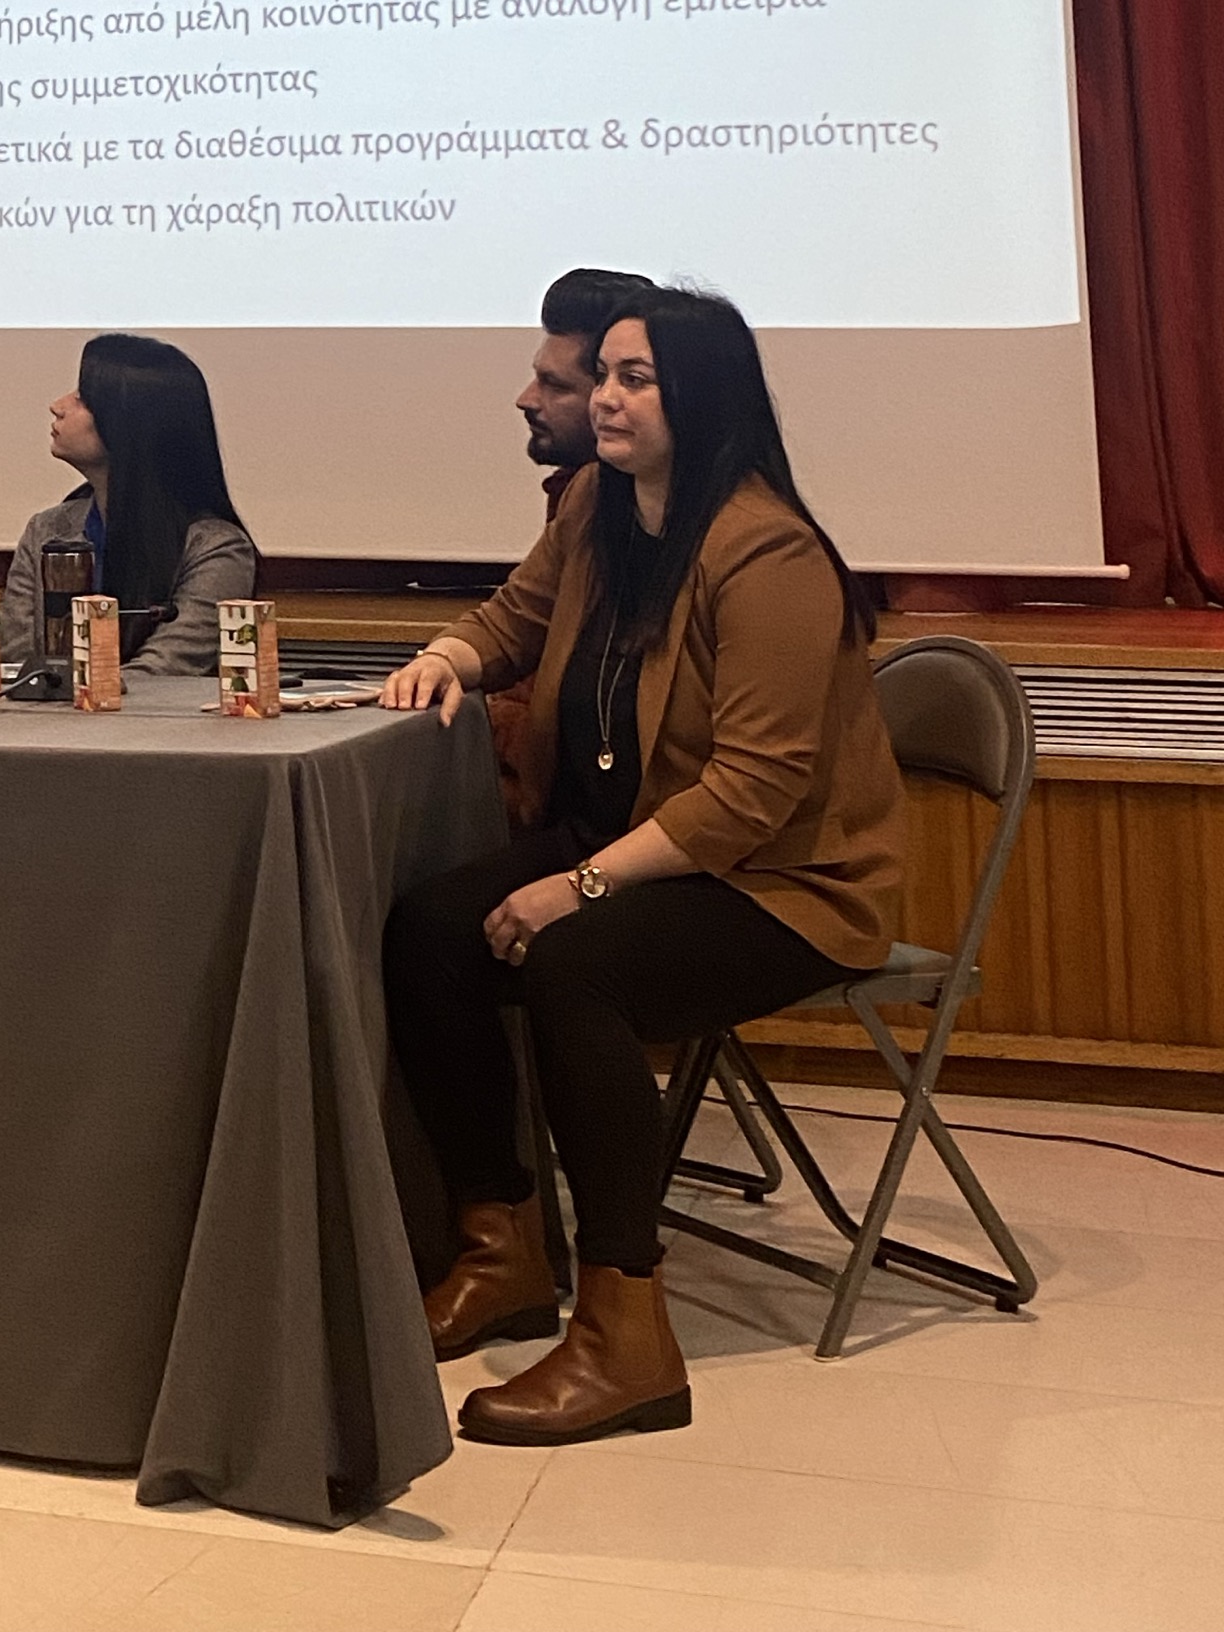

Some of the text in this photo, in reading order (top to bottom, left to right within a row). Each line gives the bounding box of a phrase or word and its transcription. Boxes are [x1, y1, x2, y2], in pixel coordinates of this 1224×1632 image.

[103, 1, 165, 35] από
[175, 0, 250, 40] μέλη
[30, 62, 318, 106] συμμετοχικότητας
[83, 139, 119, 169] με
[127, 138, 166, 161] τα
[174, 125, 343, 164] διαθέσιμα
[351, 120, 591, 163] προγράμματα
[601, 118, 629, 150] &
[640, 112, 939, 156] δραστηριότητες
[64, 204, 114, 234] για
[121, 204, 156, 233] τη
[166, 192, 281, 233] χάραξη
[291, 188, 457, 224] πολιτικών
